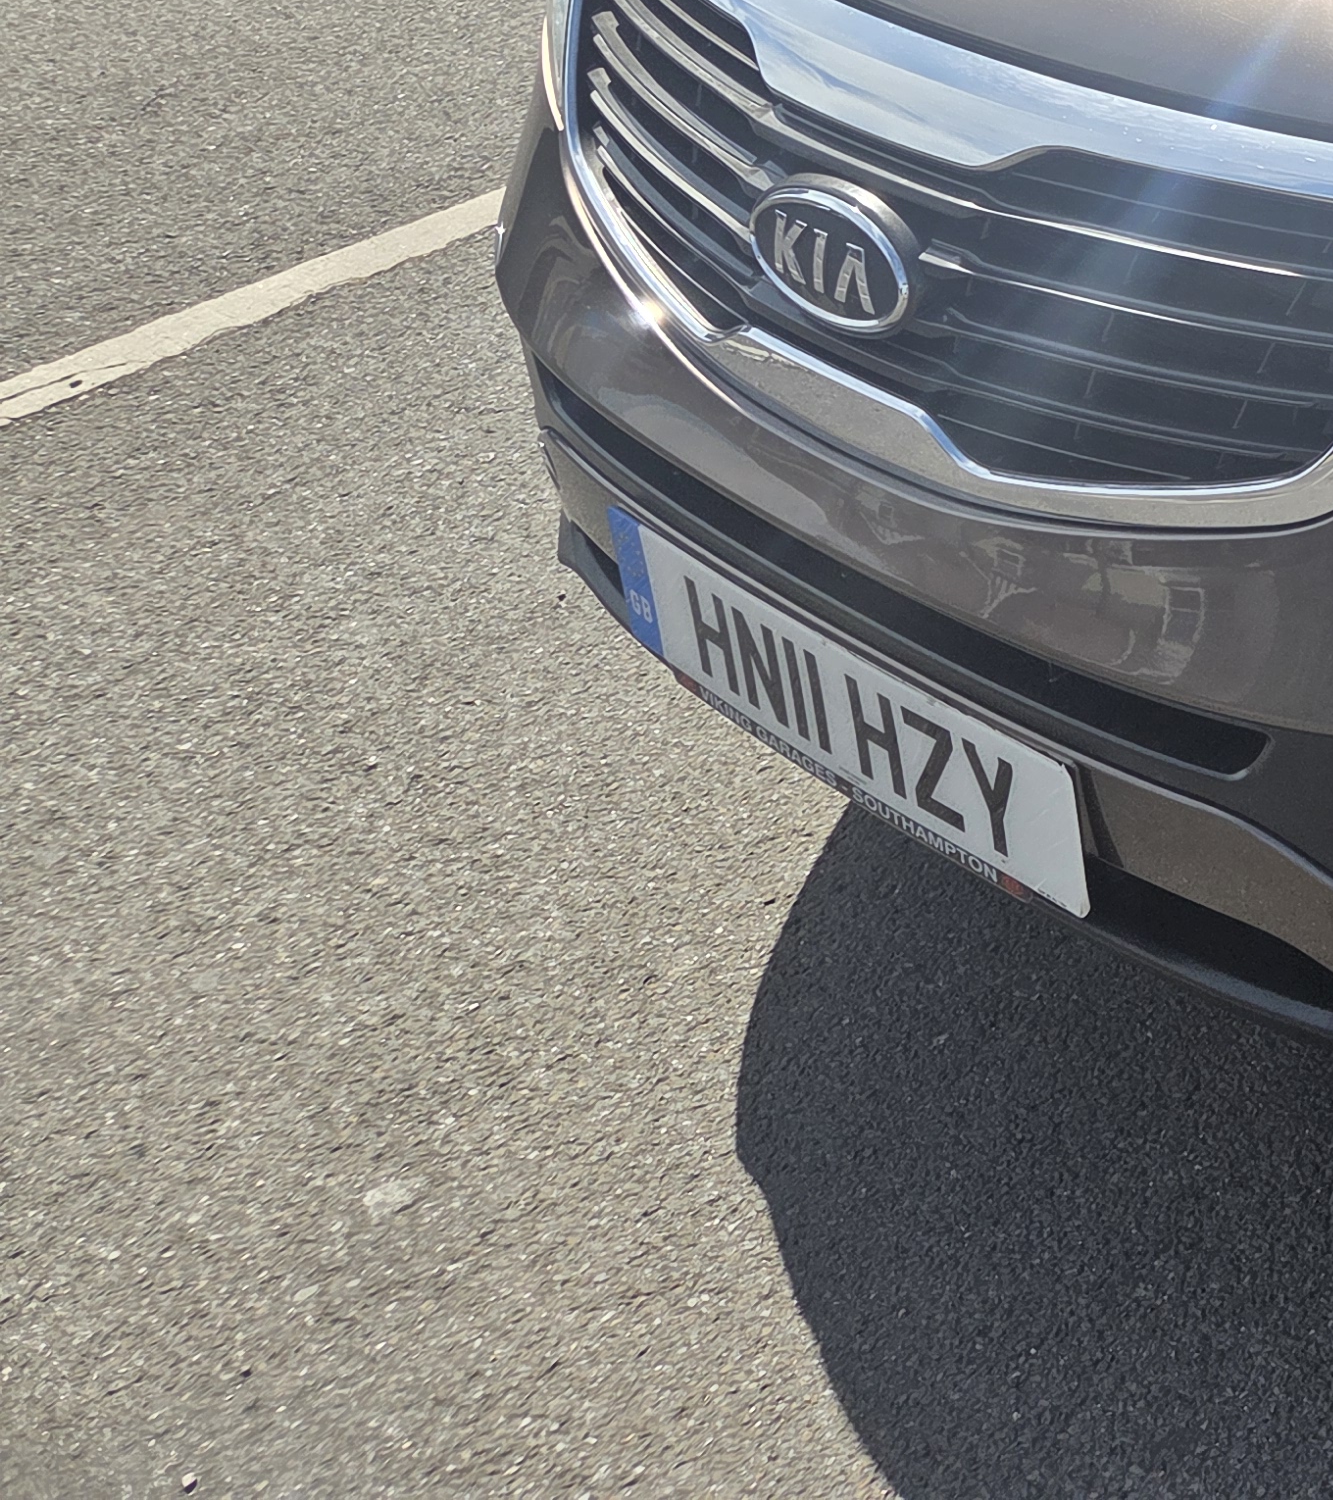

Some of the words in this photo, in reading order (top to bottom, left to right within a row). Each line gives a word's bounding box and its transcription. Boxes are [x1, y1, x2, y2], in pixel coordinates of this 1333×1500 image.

[773, 209, 877, 315] KIA
[629, 588, 653, 624] GB
[683, 575, 832, 755] HN11
[844, 674, 1014, 858] HZY
[699, 685, 754, 733] VIKING
[755, 724, 838, 786] GARAGES
[851, 784, 998, 884] SOUTHAMPTON
